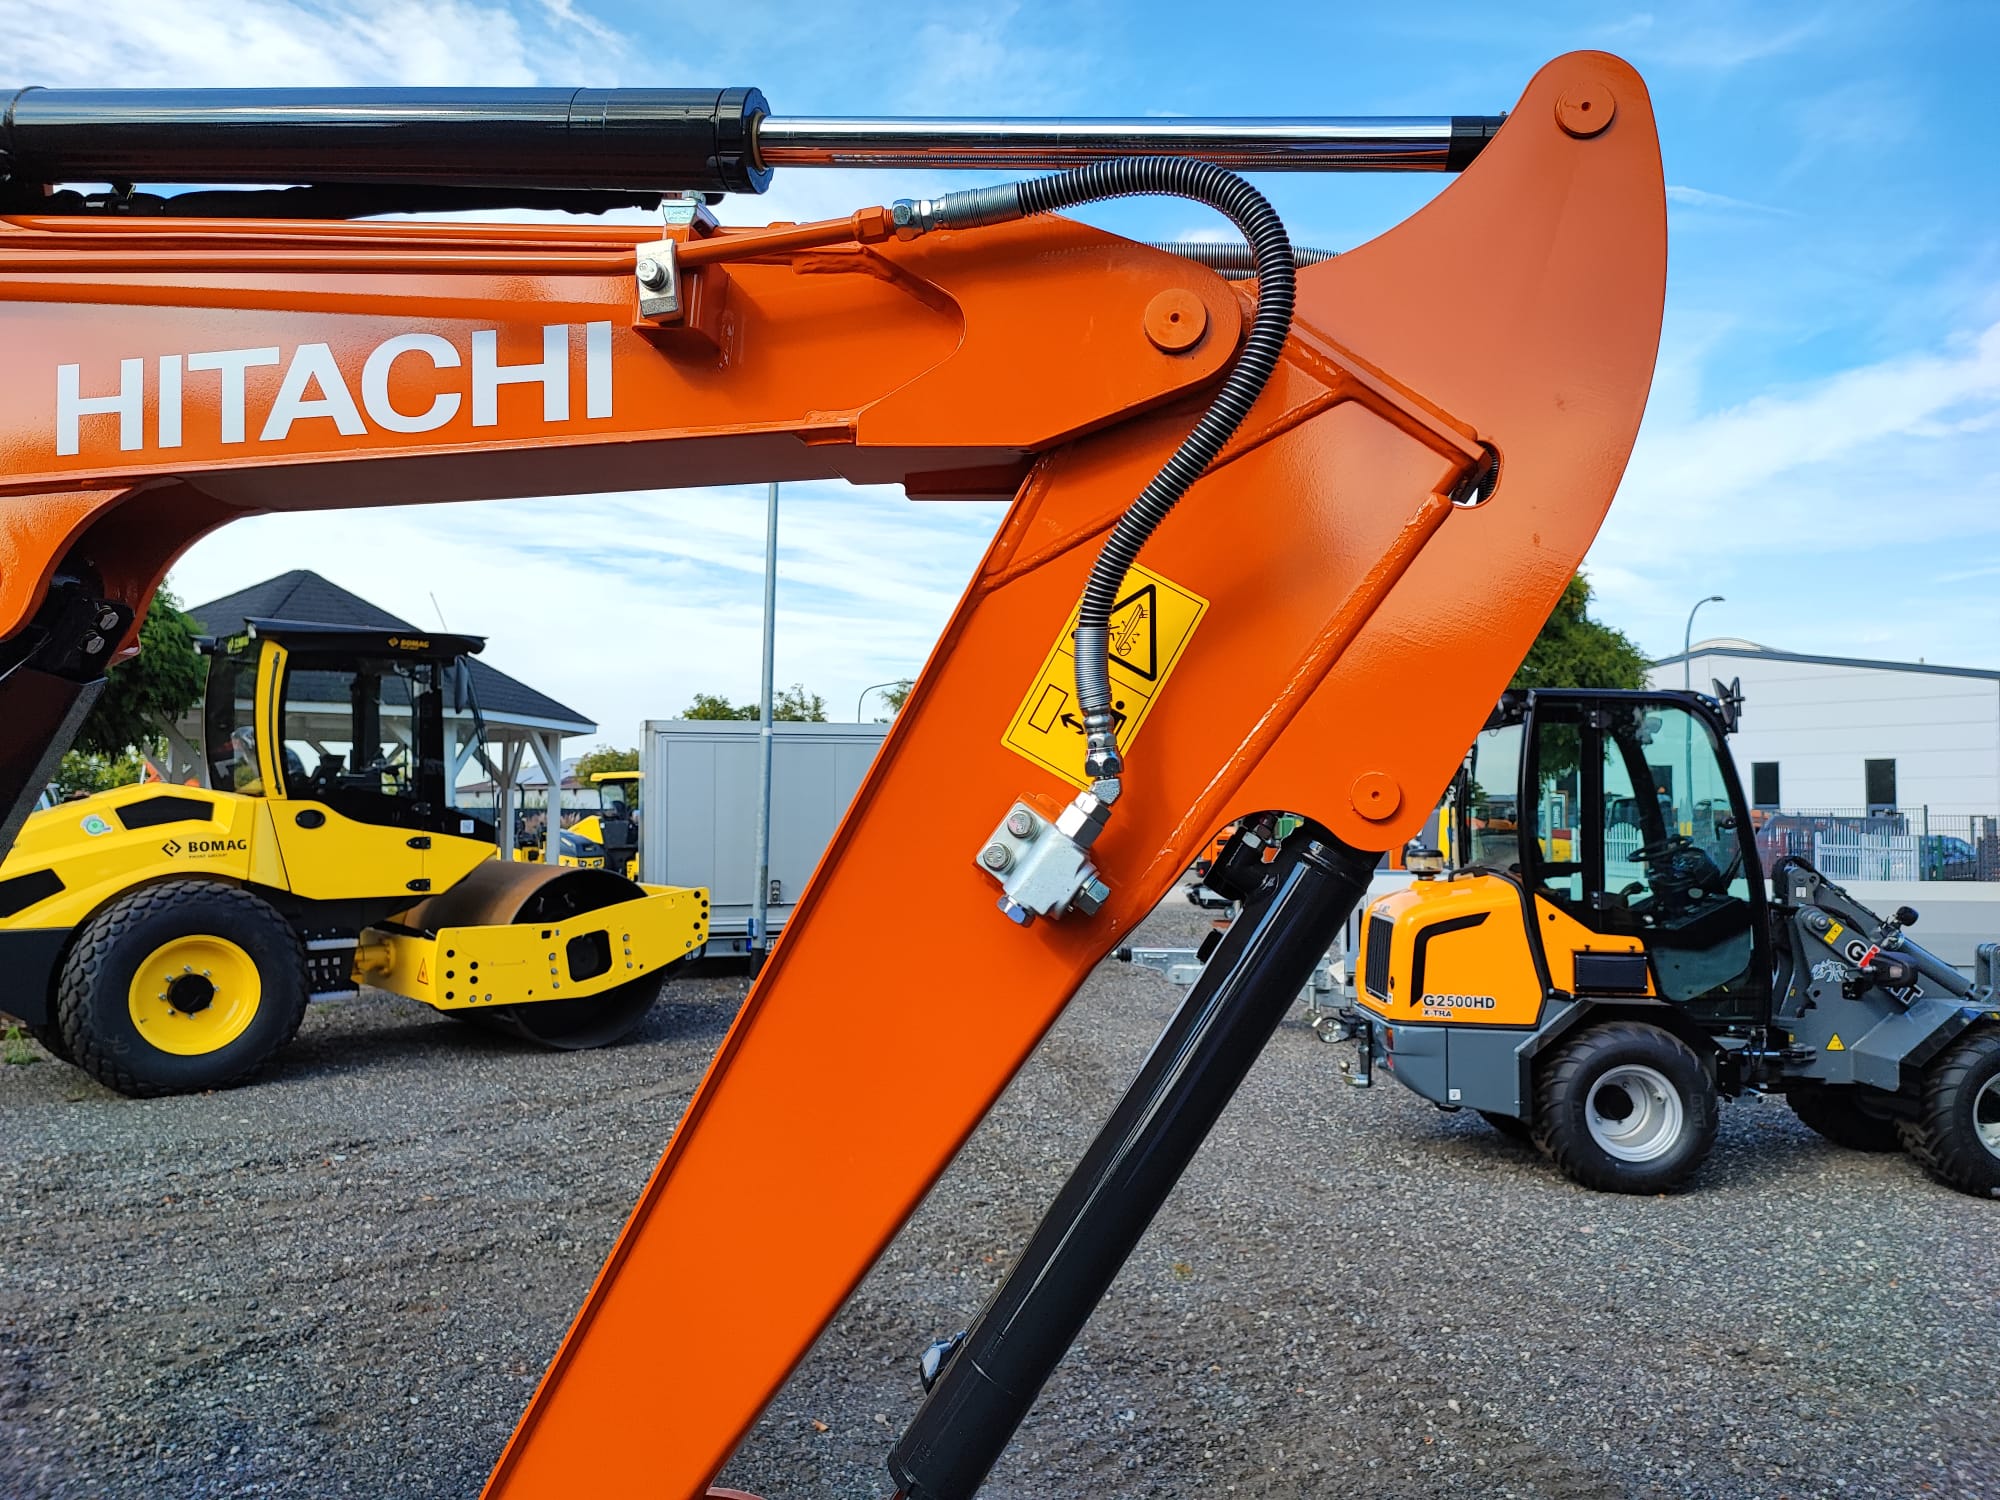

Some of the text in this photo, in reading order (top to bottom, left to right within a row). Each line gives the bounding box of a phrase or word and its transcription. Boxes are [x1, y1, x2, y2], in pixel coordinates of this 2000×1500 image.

[57, 320, 613, 456] HITACHI
[188, 840, 247, 852] BOMAG
[1423, 994, 1496, 1009] G2500HD
